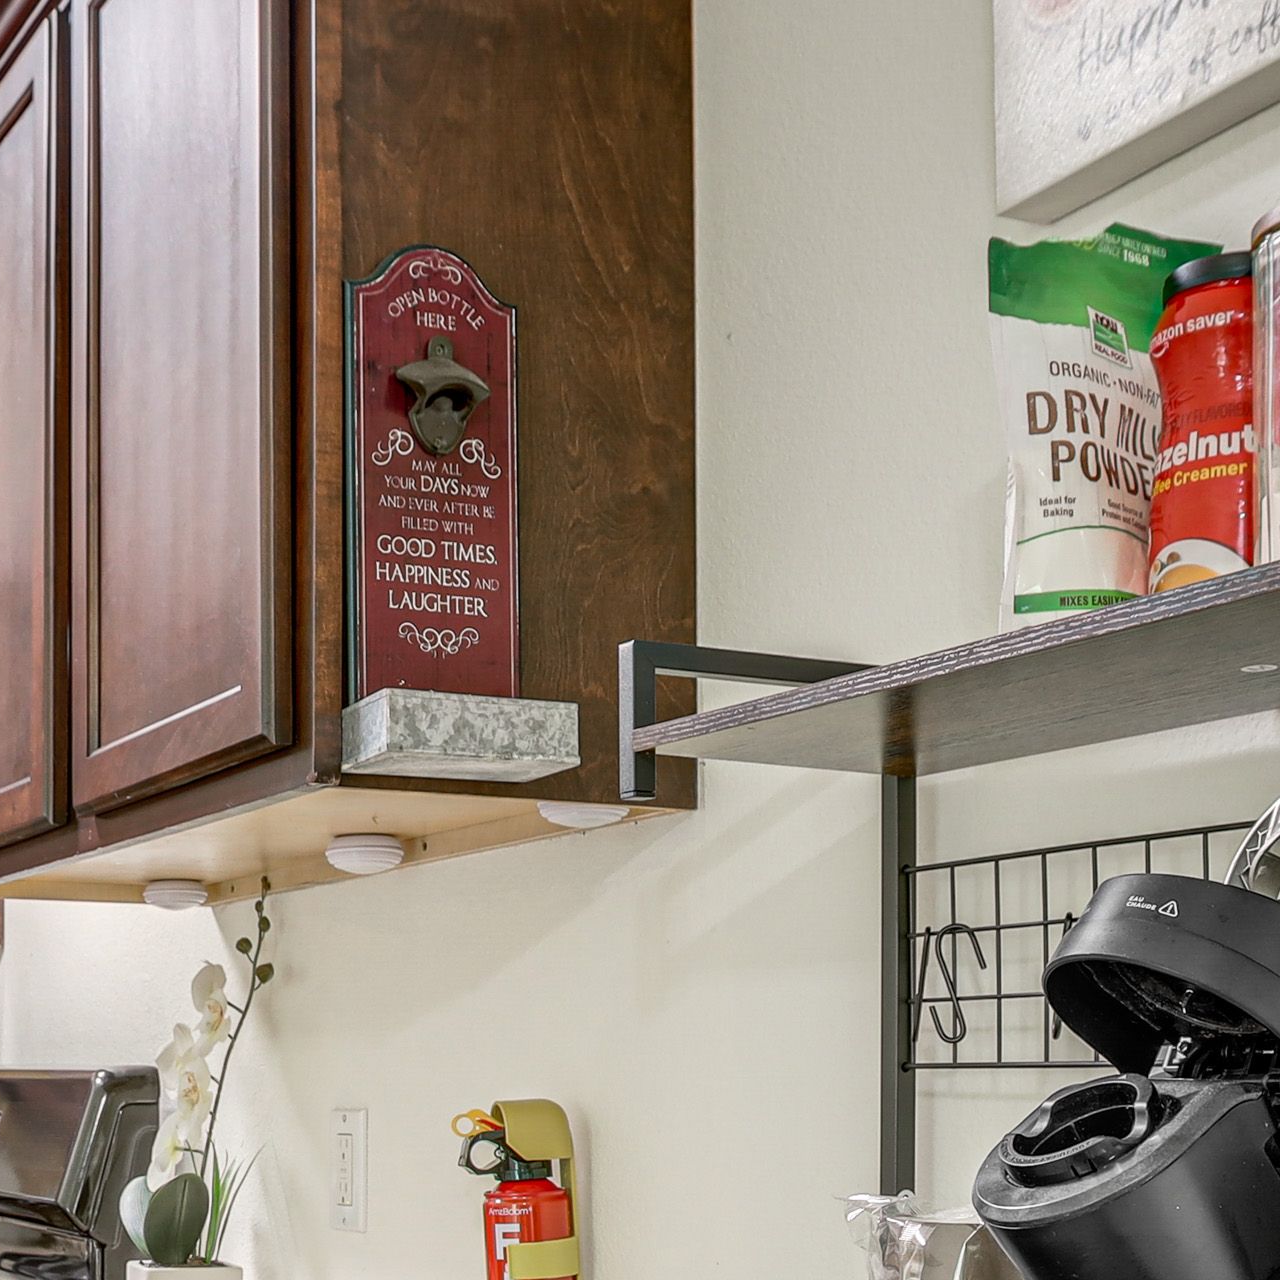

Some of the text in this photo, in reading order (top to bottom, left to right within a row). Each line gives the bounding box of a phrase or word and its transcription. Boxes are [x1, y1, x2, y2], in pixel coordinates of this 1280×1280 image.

[1123, 248, 1151, 267] 1968
[388, 288, 485, 331] OPEN BOTTLE
[416, 311, 457, 331] HERE
[1150, 310, 1235, 346] mazon saver
[1049, 360, 1161, 409] ORGANIC NON-FAT
[1026, 389, 1109, 439] DRY
[1154, 424, 1260, 477] azelnut
[411, 459, 462, 476] MAY ALL
[1050, 439, 1153, 502] POWDE
[1173, 462, 1248, 487] Creamer
[384, 475, 490, 498] YOUR DAYS NOW
[378, 494, 496, 519] AND EVER AFTER BE
[1039, 496, 1077, 506] Ideal for
[1043, 508, 1074, 518] Baking
[401, 516, 474, 536] FILLED WITH
[377, 534, 436, 558] GOOD
[375, 561, 500, 591] HAPPINESS AND
[388, 589, 488, 618] LAUGHTER
[1059, 596, 1089, 606] MIXES
